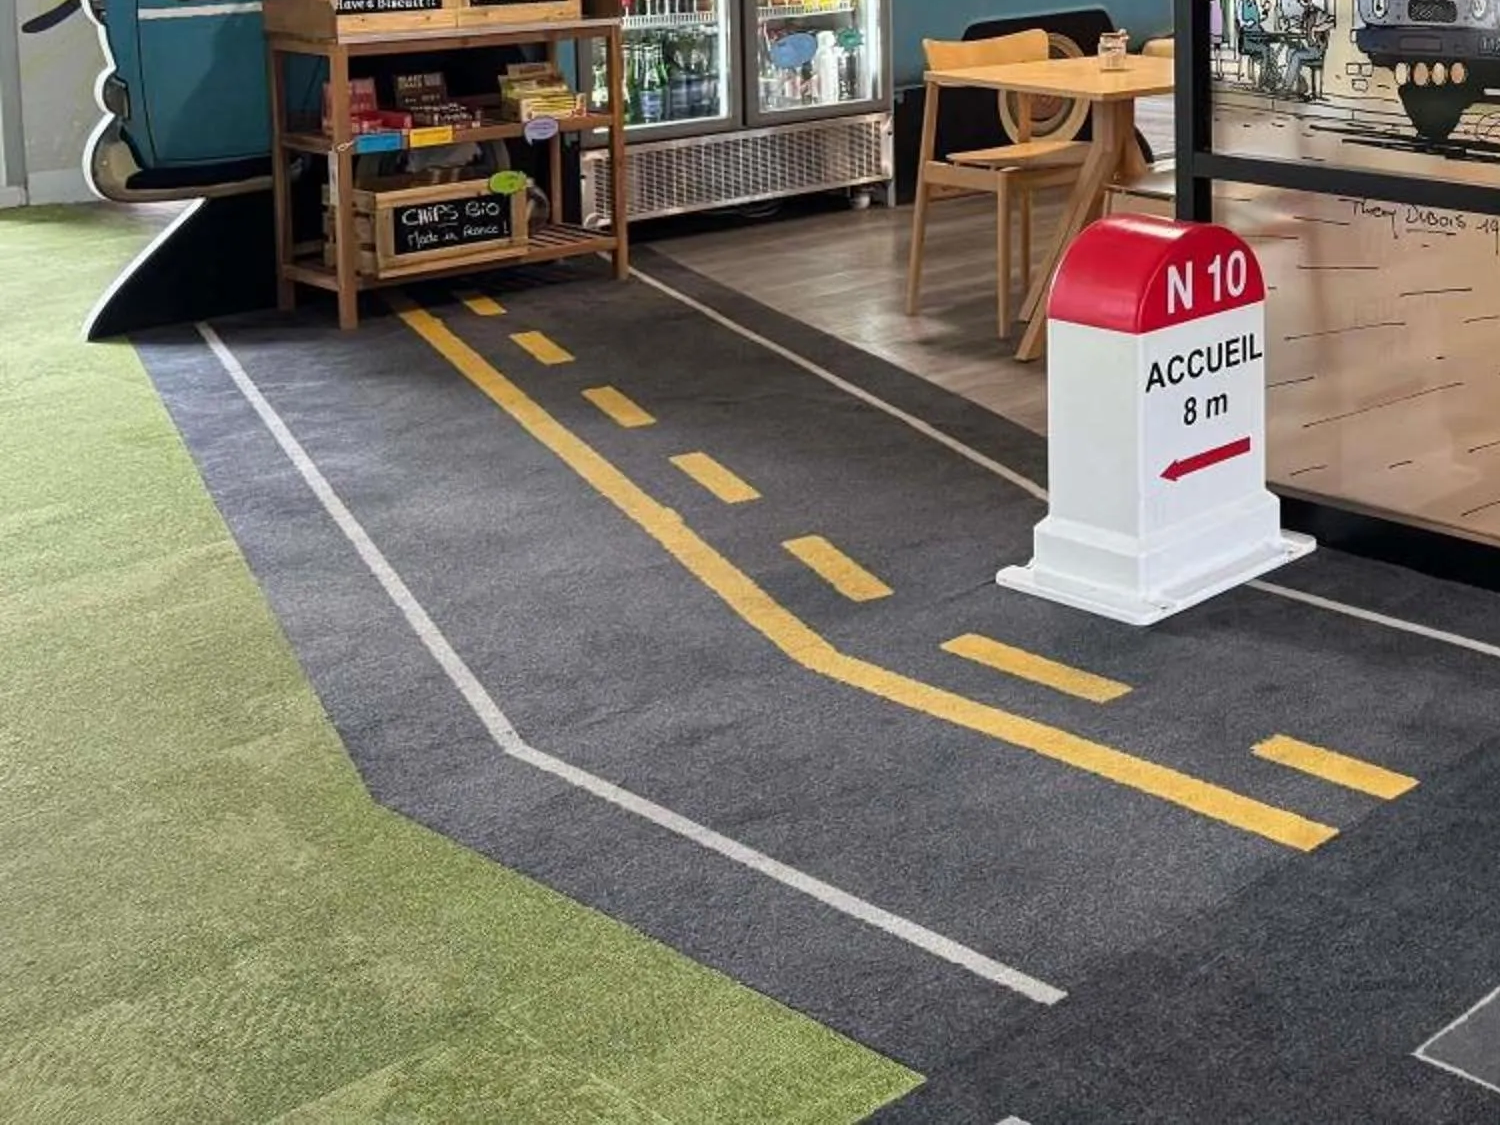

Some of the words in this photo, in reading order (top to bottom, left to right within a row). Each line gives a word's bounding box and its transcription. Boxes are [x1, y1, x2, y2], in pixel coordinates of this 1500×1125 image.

[1167, 261, 1194, 315] N
[1207, 250, 1247, 302] 10
[1145, 333, 1262, 393] ACCUEIL
[1183, 397, 1197, 425] 8
[1206, 393, 1228, 418] m
